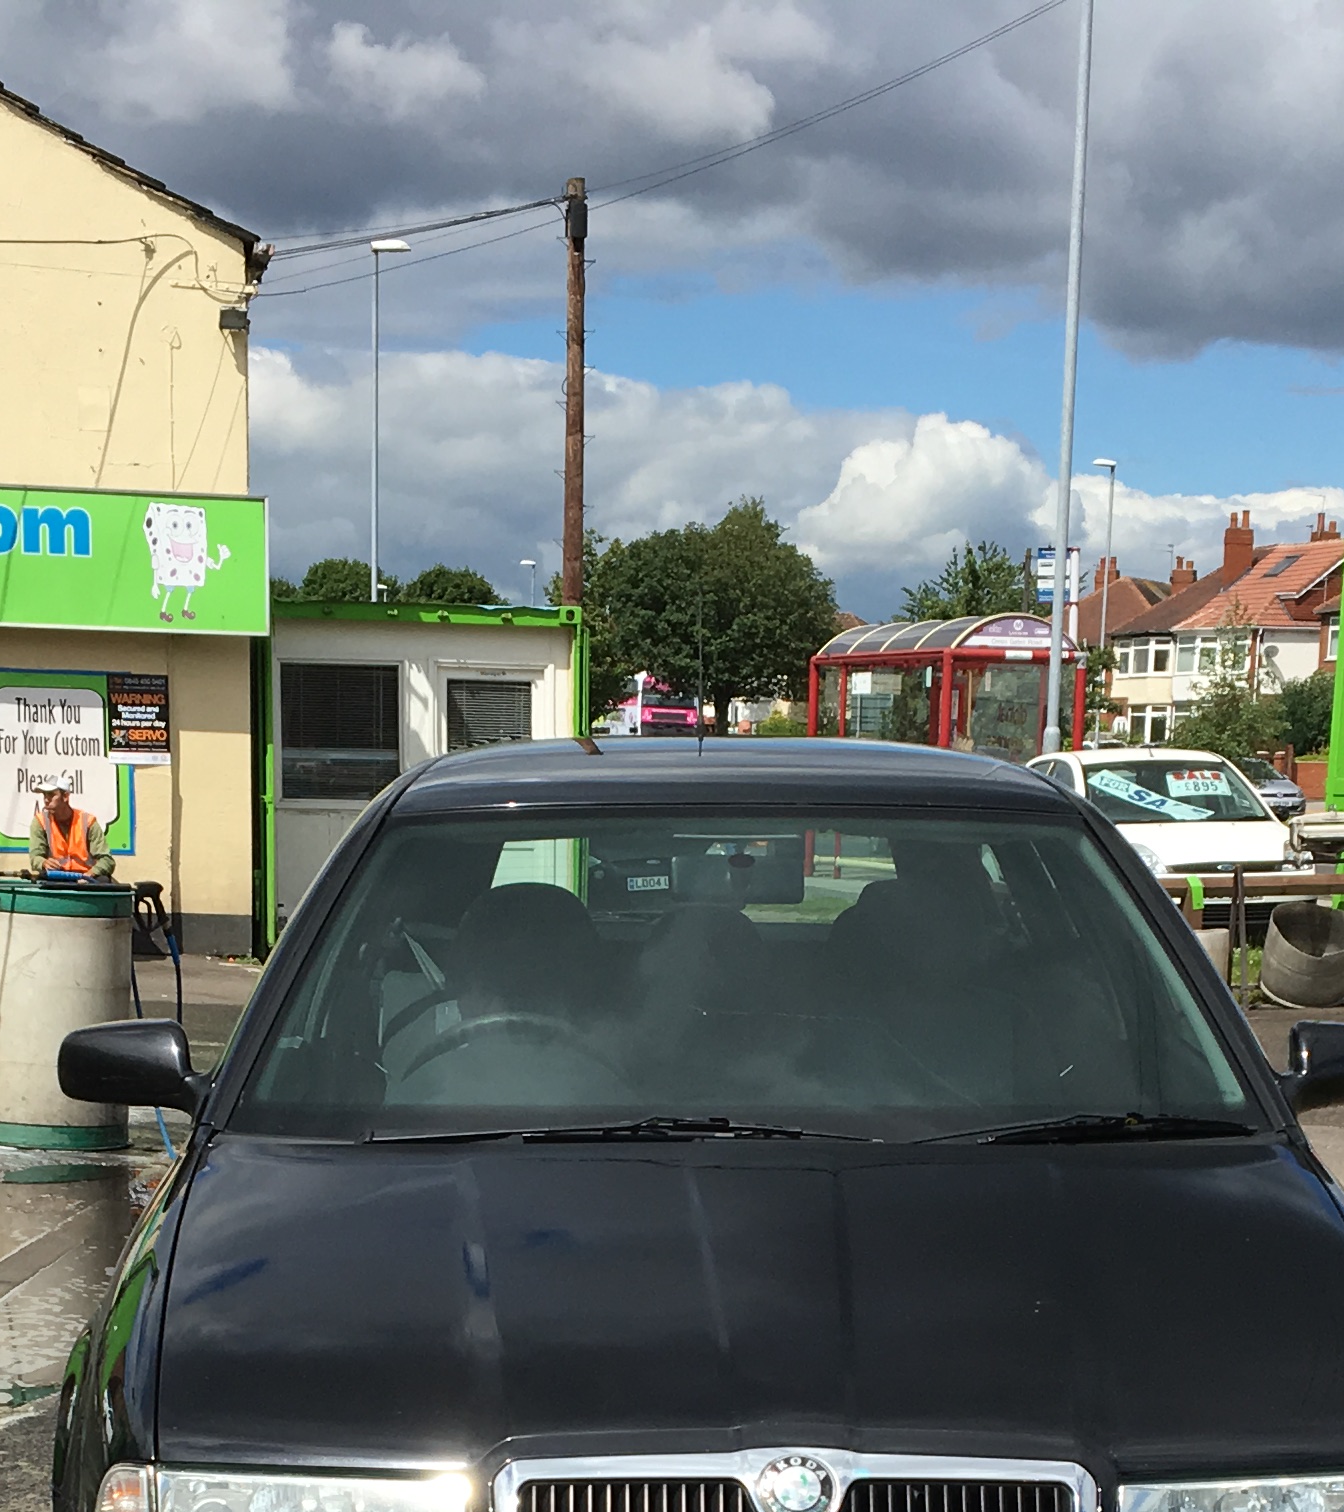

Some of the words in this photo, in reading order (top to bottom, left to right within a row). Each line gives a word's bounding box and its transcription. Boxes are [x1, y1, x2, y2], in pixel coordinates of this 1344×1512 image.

[110, 693, 166, 704] WARNING
[15, 697, 56, 724] Thank
[59, 699, 81, 724] You
[117, 704, 145, 712] Secured
[153, 720, 166, 728] day
[128, 729, 167, 740] SERVO
[22, 730, 50, 755] Your
[55, 731, 100, 757] Custom
[1185, 781, 1219, 792] £895
[764, 1456, 828, 1481] KODA
